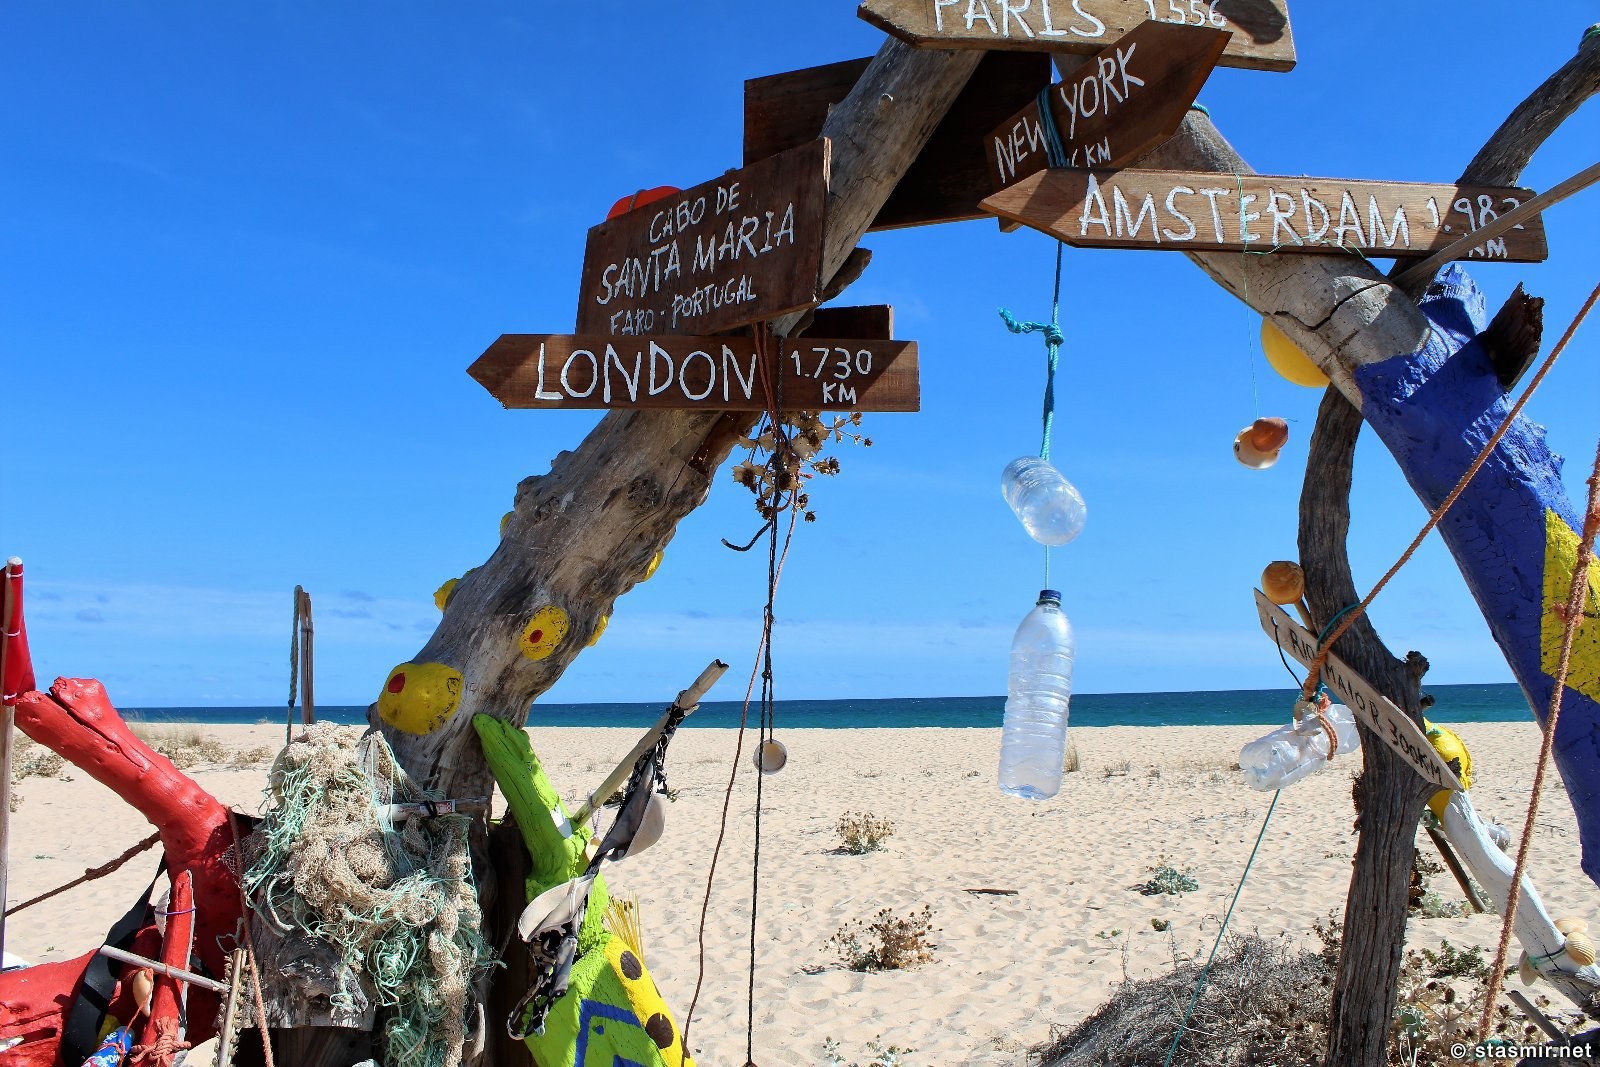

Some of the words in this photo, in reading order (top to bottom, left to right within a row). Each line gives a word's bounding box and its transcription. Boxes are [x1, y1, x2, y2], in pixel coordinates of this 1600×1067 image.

[932, 0, 1107, 39] PARIS
[994, 116, 1048, 184] NEW
[1059, 42, 1145, 140] YORK
[1084, 135, 1112, 168] KM
[649, 196, 706, 244] CABO
[715, 182, 741, 215] DE
[1078, 172, 1411, 248] AMSTERDAM
[596, 239, 681, 305] SANTA
[692, 202, 795, 274] MARIA
[610, 308, 654, 336] FARO
[671, 274, 757, 329] PORTUGAL
[534, 340, 758, 403] LONDON
[790, 347, 873, 380] 1.730
[822, 380, 858, 405] KM
[1289, 628, 1316, 662] RIO
